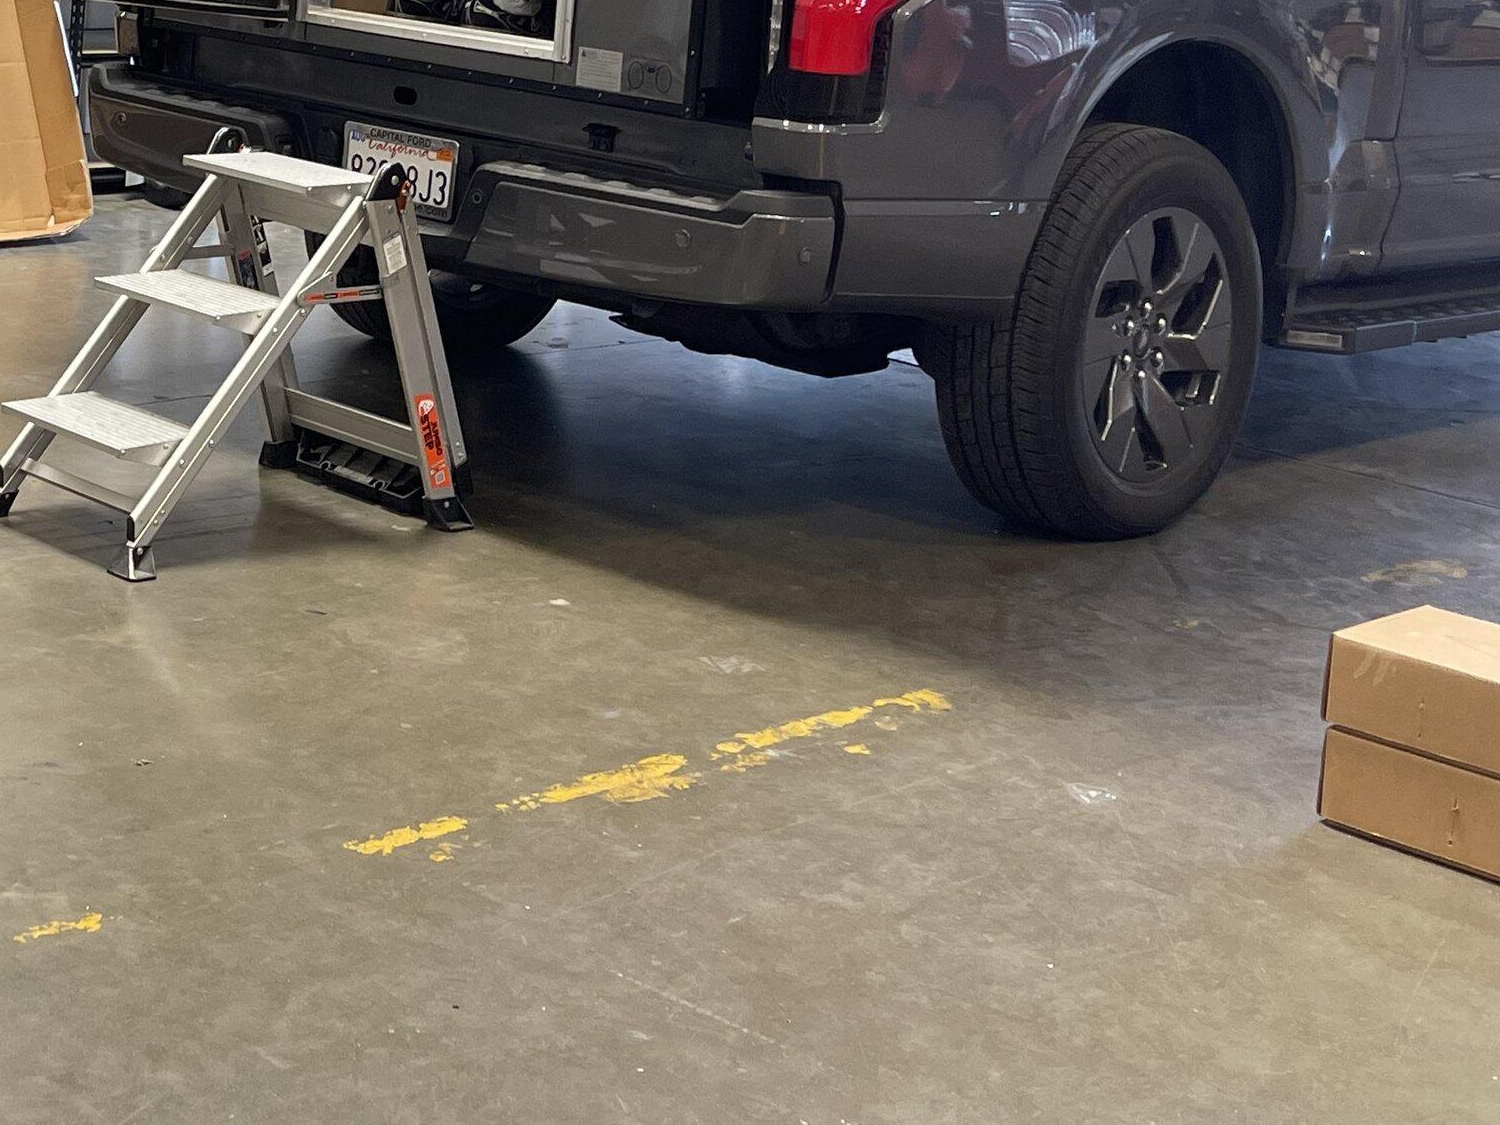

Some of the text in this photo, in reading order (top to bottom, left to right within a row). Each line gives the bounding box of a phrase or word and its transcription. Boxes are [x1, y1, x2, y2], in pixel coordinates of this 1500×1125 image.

[367, 138, 429, 158] California
[369, 127, 405, 144] CAPITAL
[406, 137, 432, 148] FORD
[351, 153, 448, 206] 828J3
[420, 414, 434, 451] STEP
[430, 420, 443, 455] JUMBO
